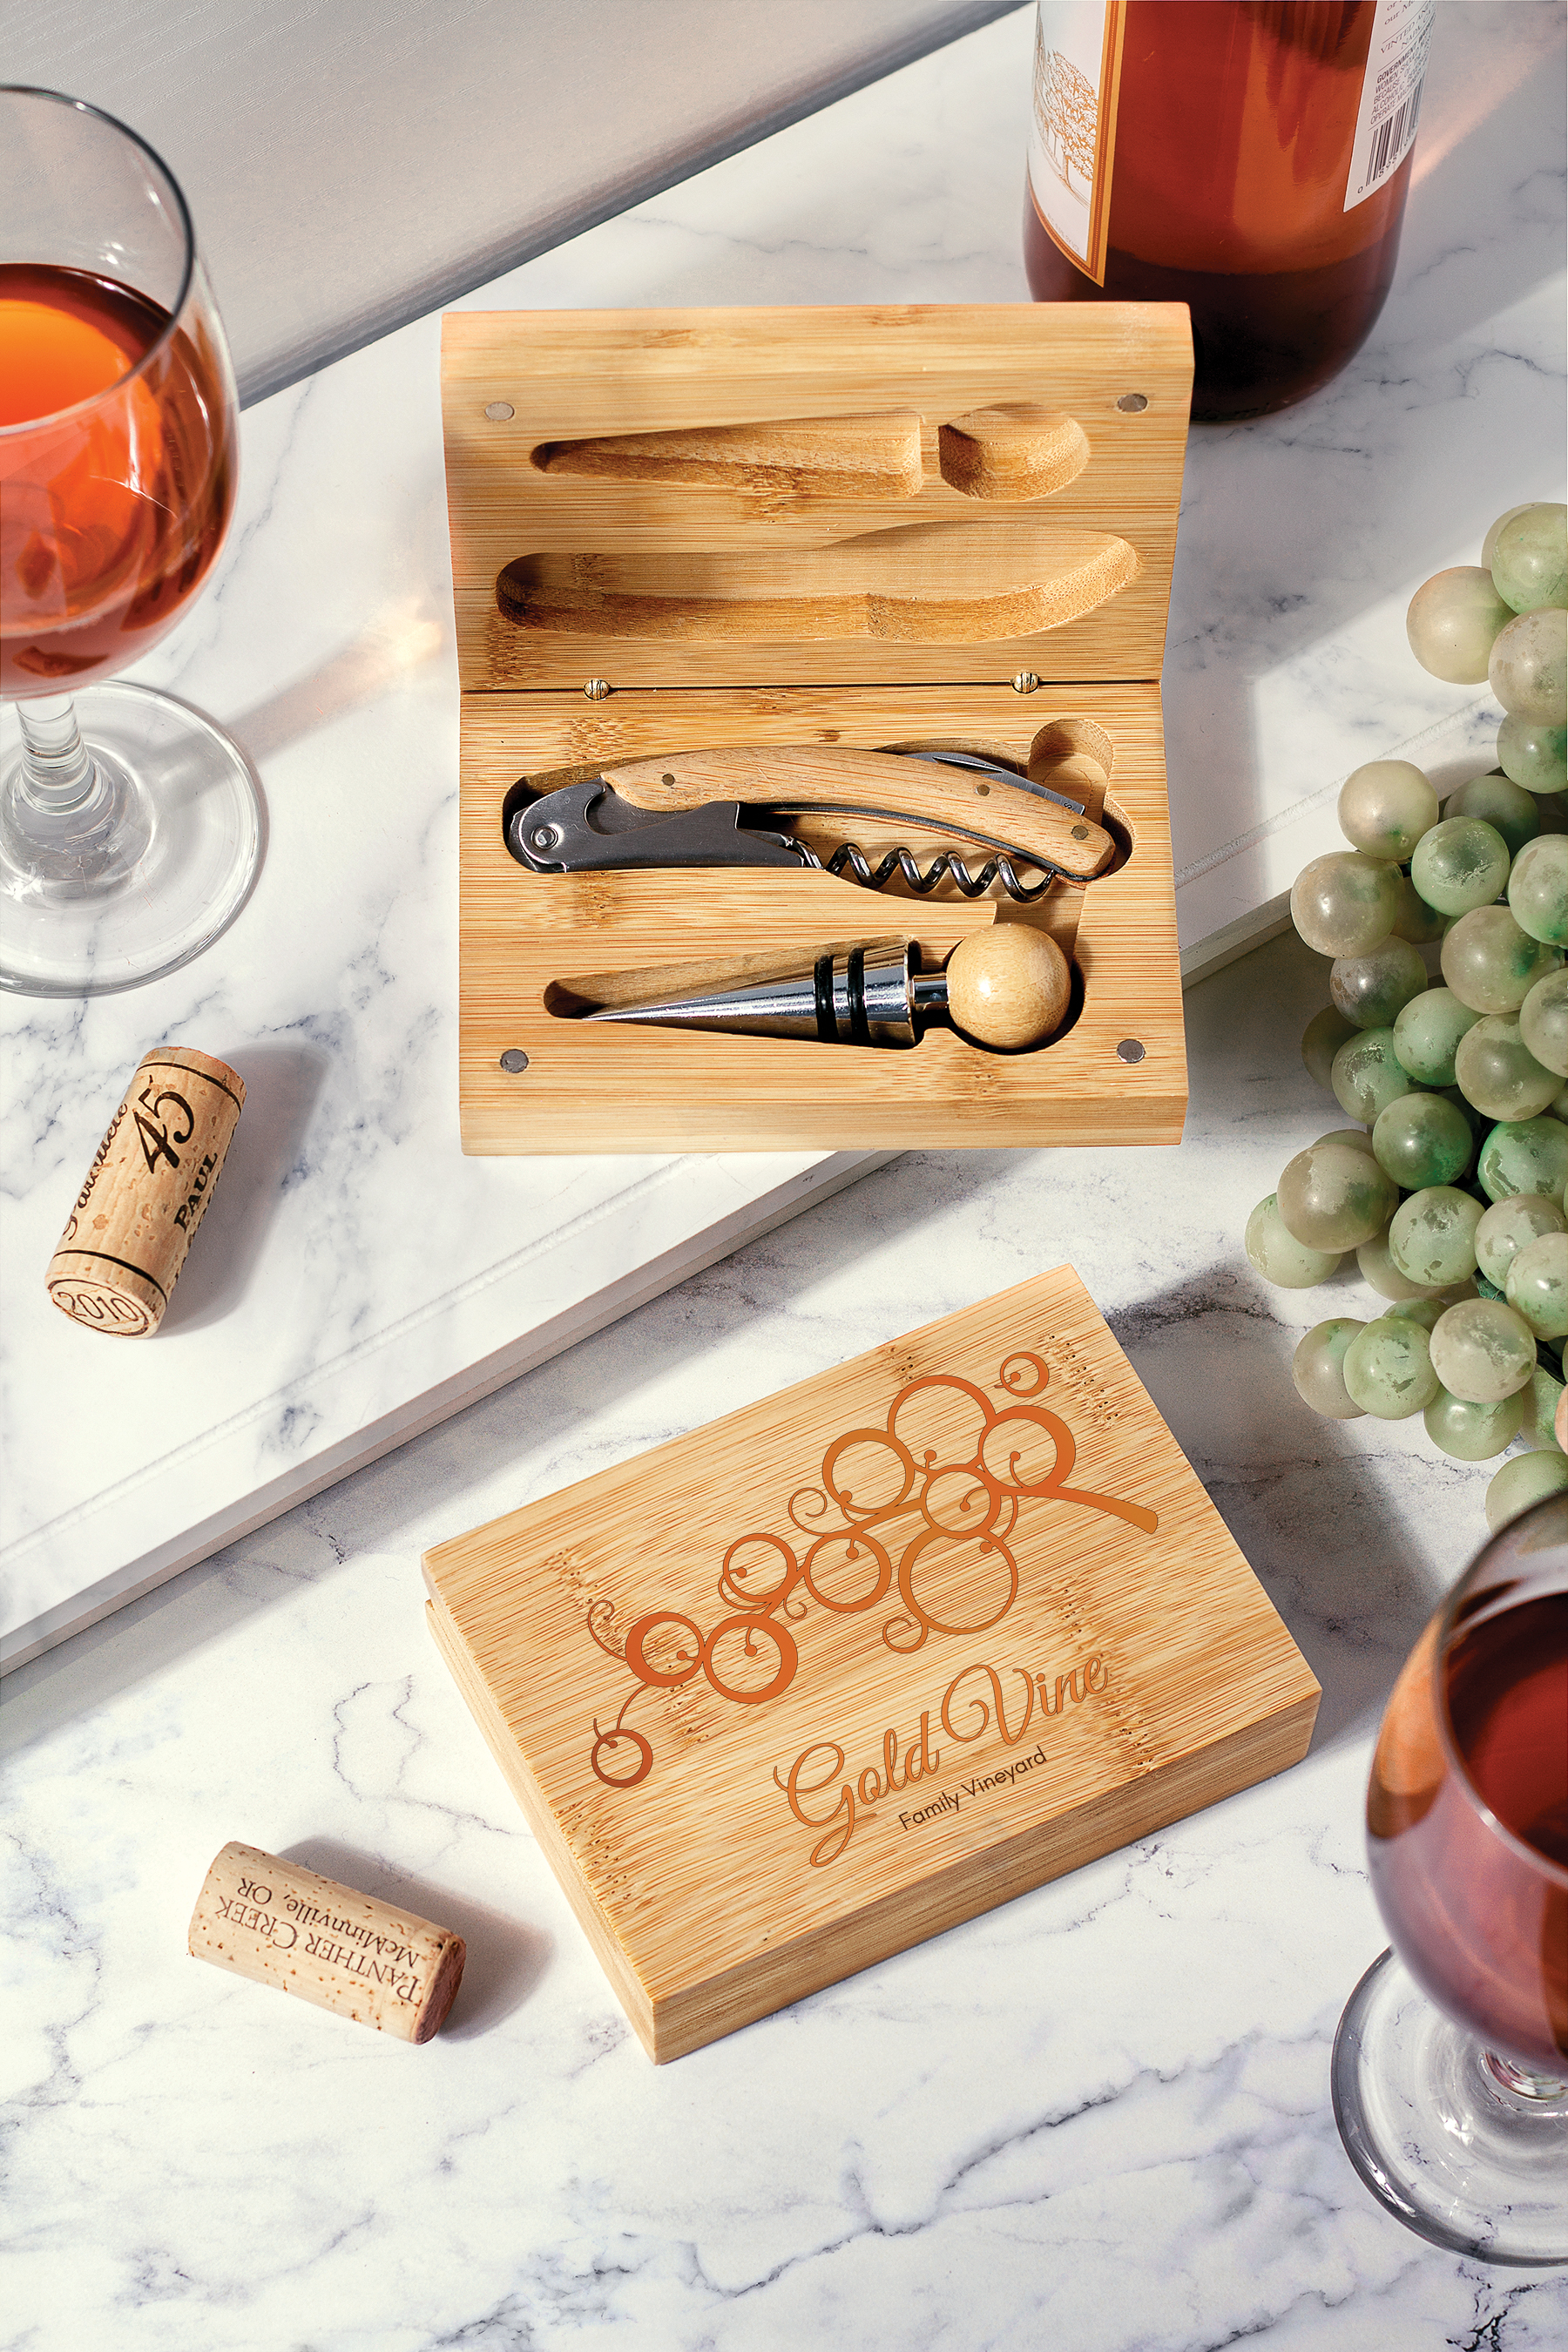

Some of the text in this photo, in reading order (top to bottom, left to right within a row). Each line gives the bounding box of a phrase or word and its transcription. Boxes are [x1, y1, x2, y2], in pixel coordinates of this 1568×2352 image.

[1381, 21, 1416, 53] VINTED
[1384, 10, 1401, 25] our
[1376, 40, 1417, 84] GOVERNMENT
[1371, 81, 1406, 116] ALCOHOLIC
[1374, 75, 1402, 105] BECAUSE
[1375, 70, 1400, 94] WOMEN
[1370, 97, 1398, 125] OPERATE
[132, 1074, 196, 1174] 45
[173, 1152, 219, 1233] PAUL
[57, 1291, 139, 1322] 2010
[774, 1657, 1108, 1868] Gold Vine
[898, 1745, 1048, 1830] Family Vineyard
[236, 1877, 420, 1970] McMinnville, OR
[214, 1895, 422, 2004] PANTHER CREEK
